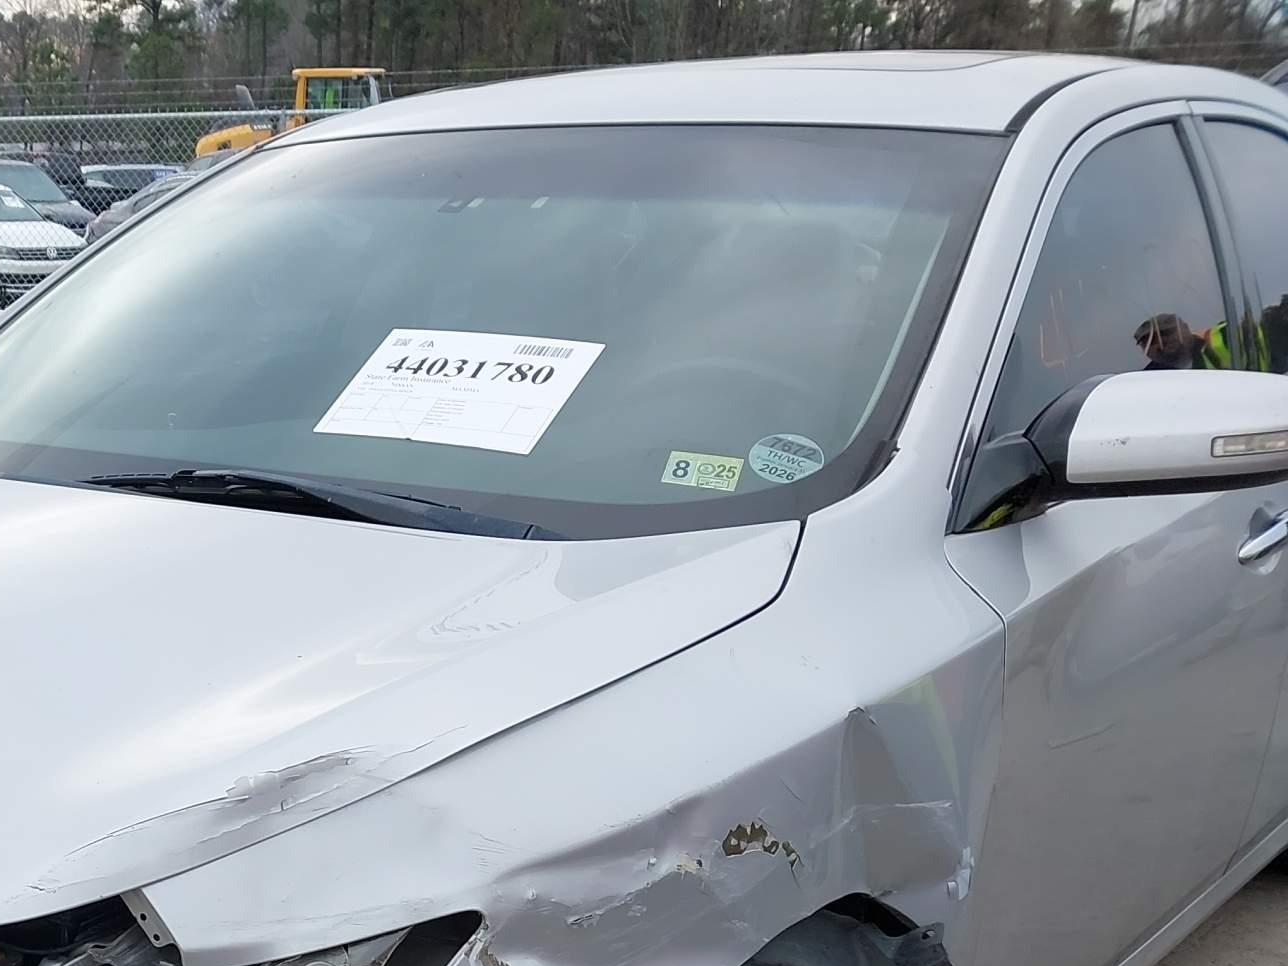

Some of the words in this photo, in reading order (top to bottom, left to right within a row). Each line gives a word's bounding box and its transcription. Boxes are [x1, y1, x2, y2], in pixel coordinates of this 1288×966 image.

[386, 355, 555, 385] 44031780
[769, 436, 817, 461] 7672
[767, 449, 807, 468] TH/WC
[672, 460, 690, 478] 8
[714, 464, 738, 479] 25
[758, 463, 797, 481] 2026
